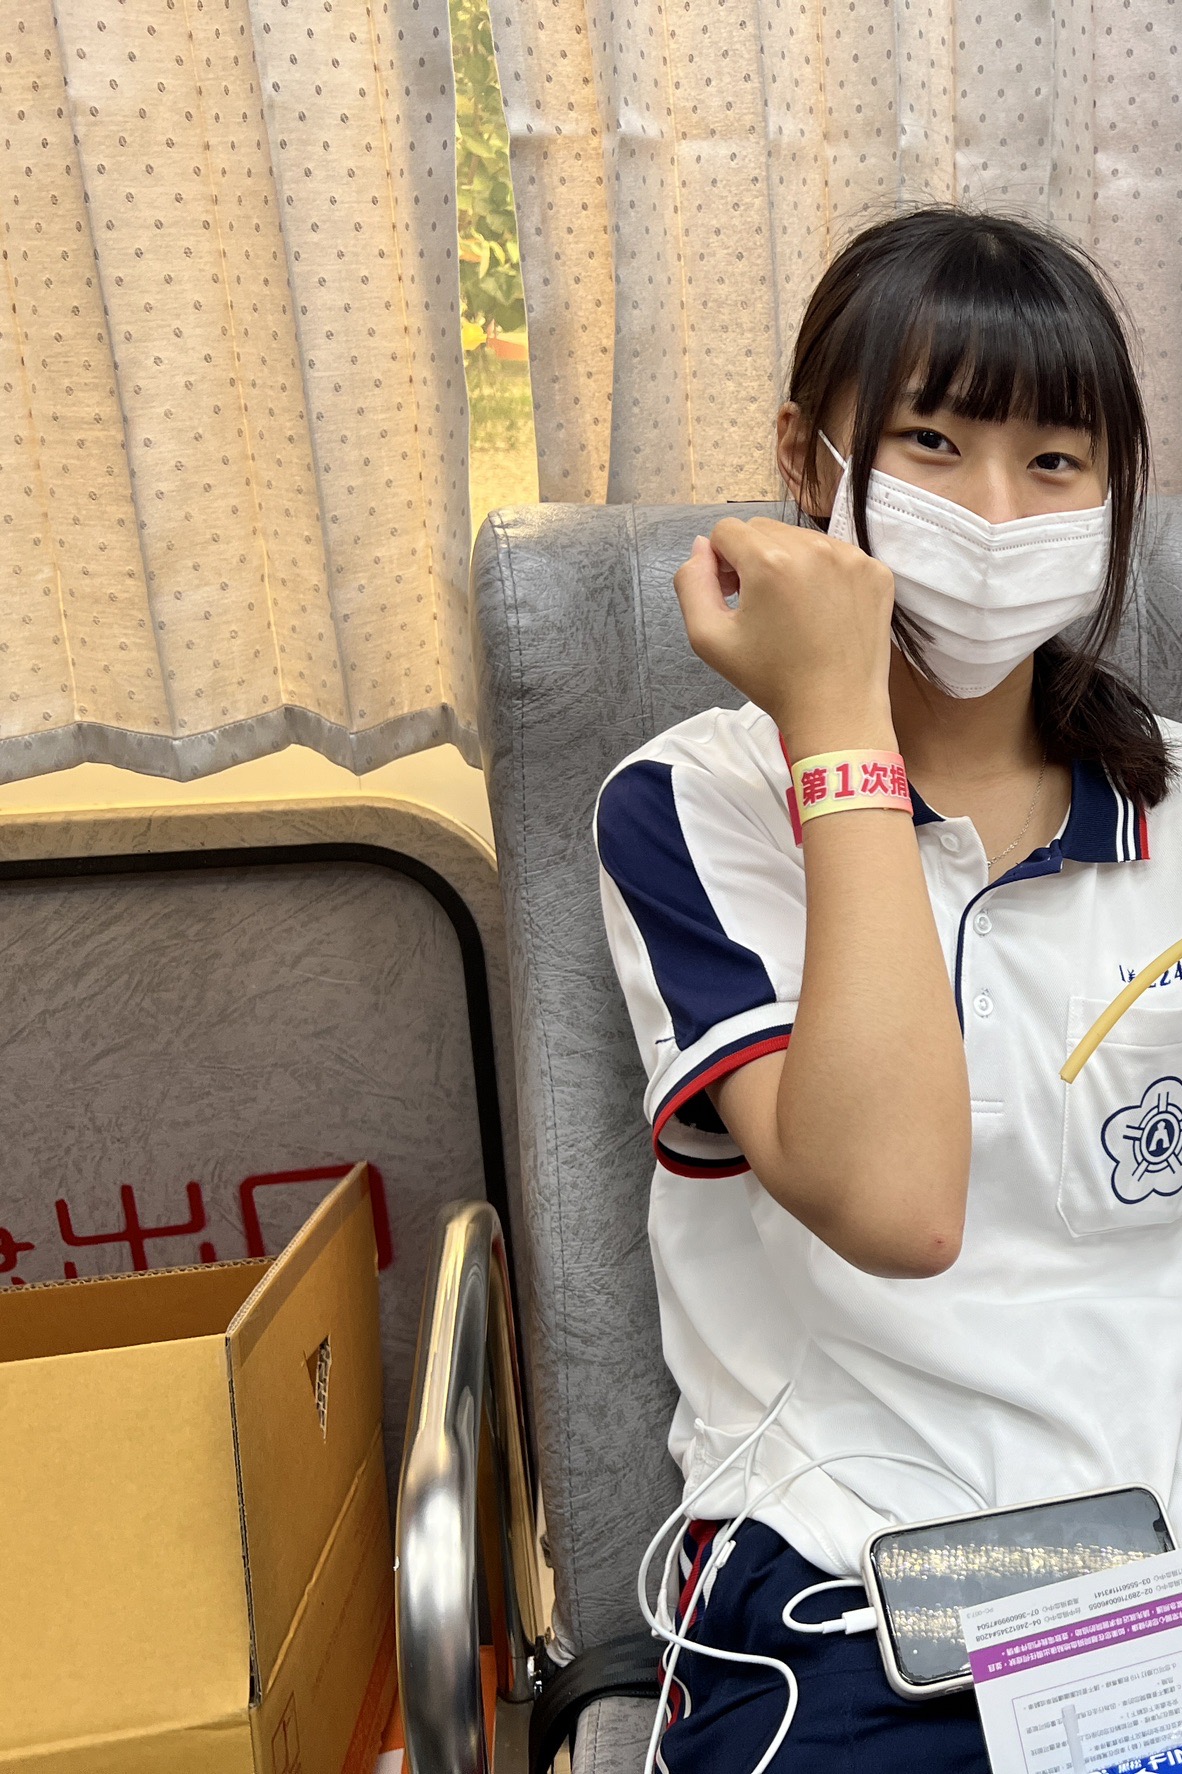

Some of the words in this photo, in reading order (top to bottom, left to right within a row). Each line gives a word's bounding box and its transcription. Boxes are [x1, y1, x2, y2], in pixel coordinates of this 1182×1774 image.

[1087, 1587, 1153, 1610] 02-28971600#6055
[1093, 1577, 1151, 1598] 03-5556111#3141
[975, 1618, 1041, 1641] 04-24612345#4208
[976, 1608, 1039, 1630] 07-3660999#7504
